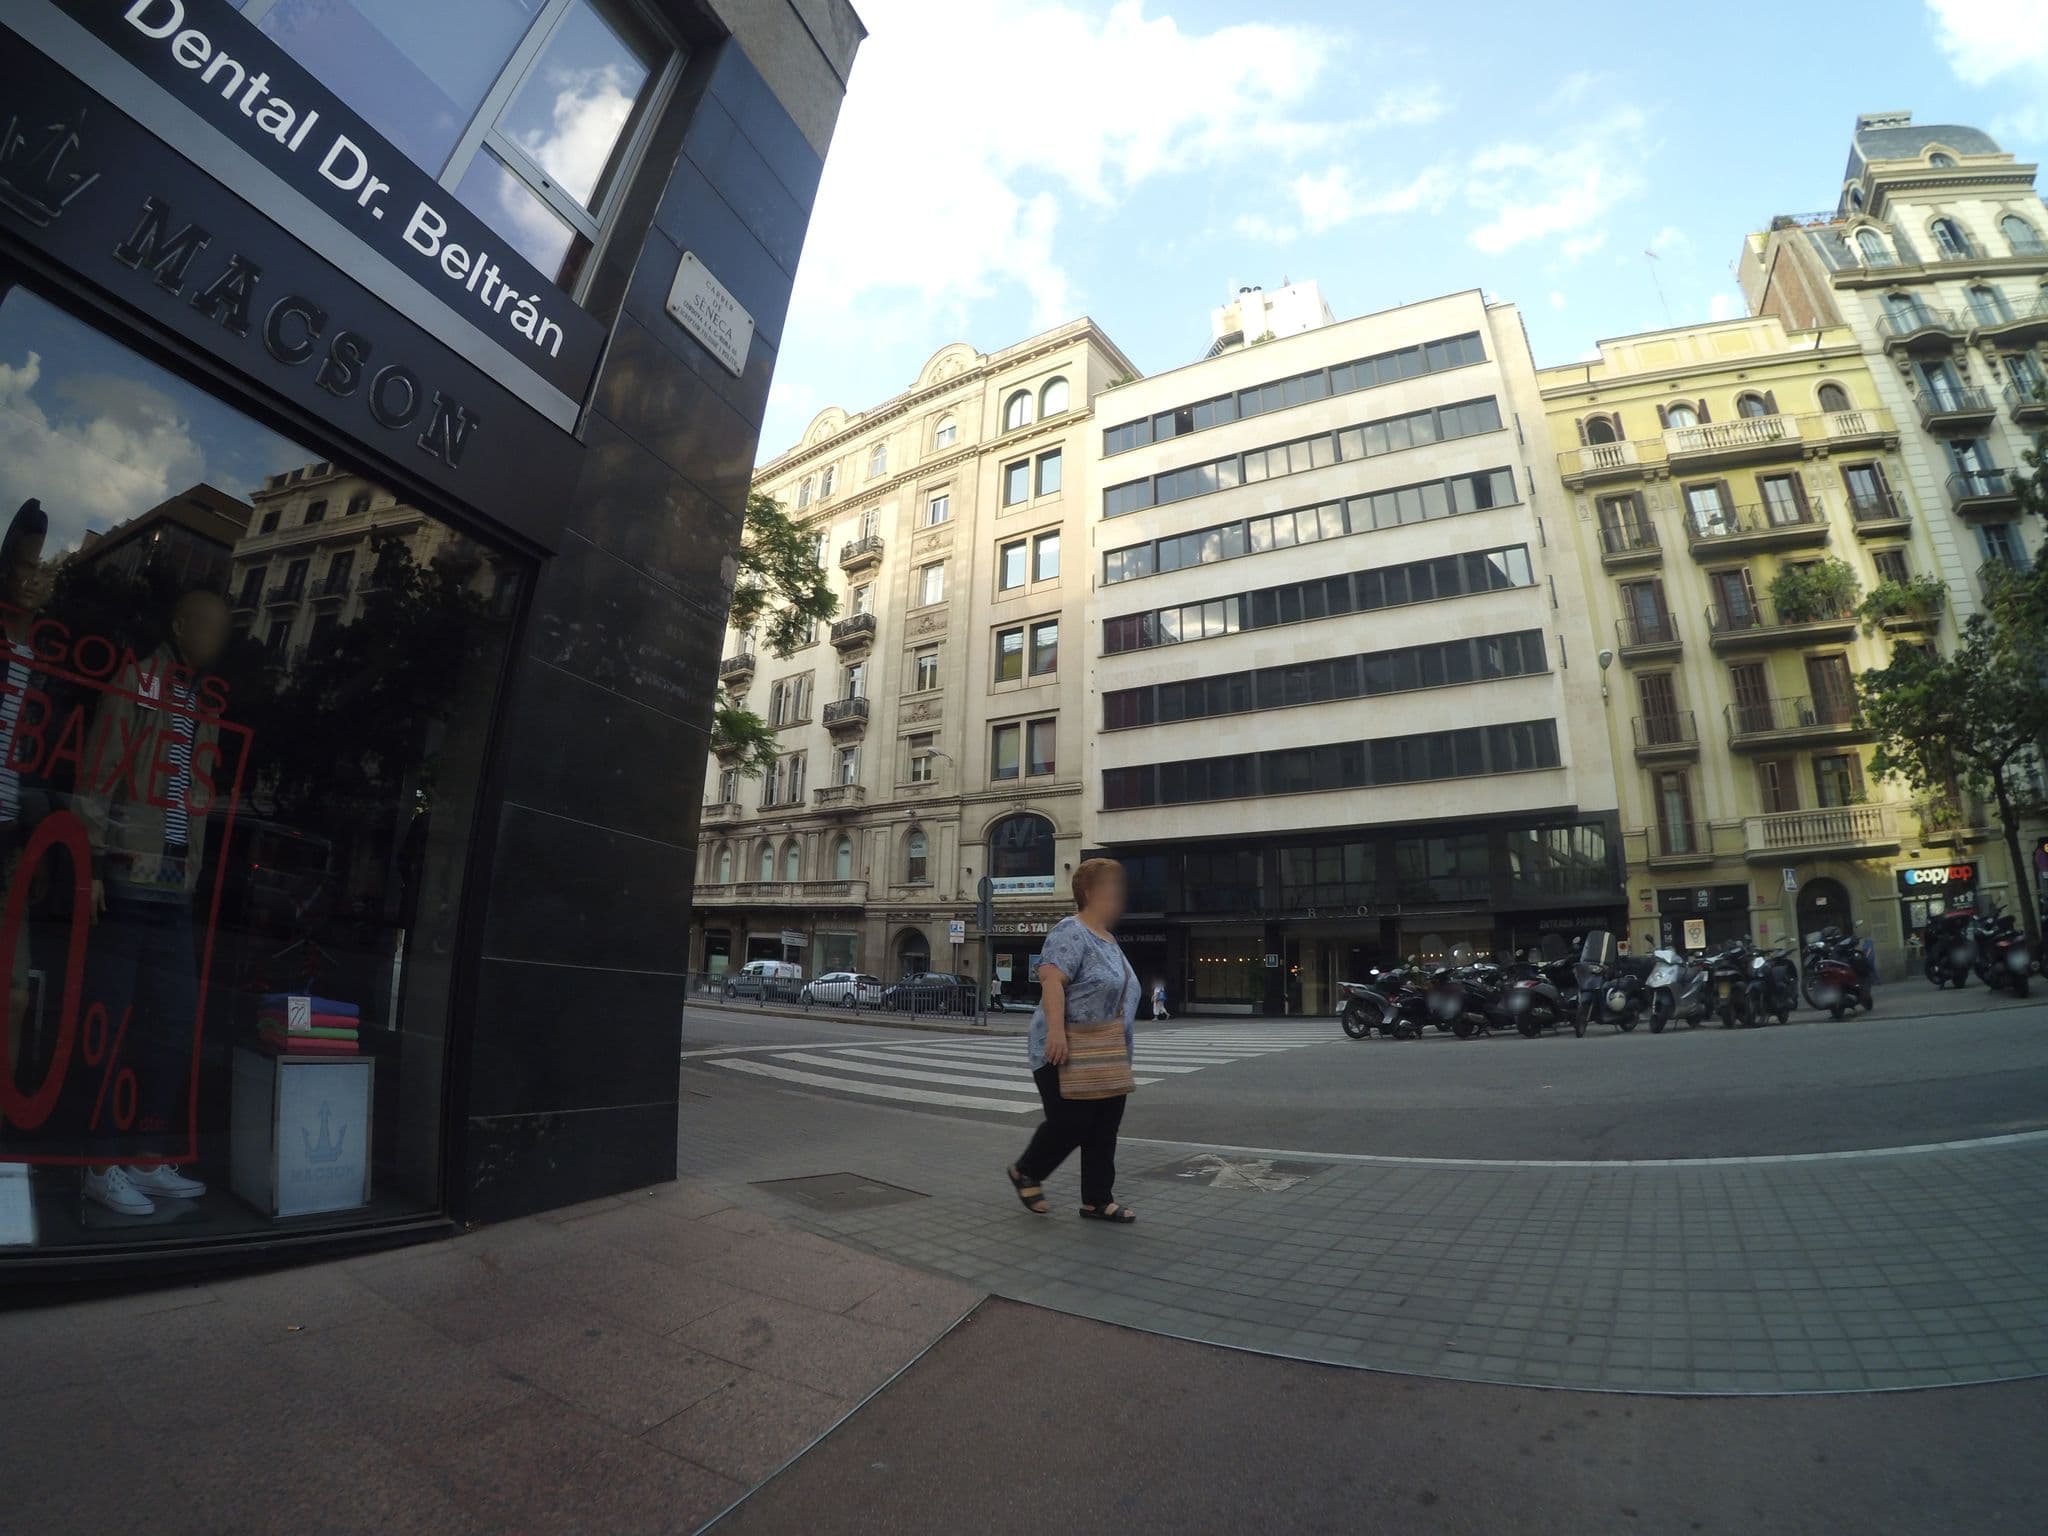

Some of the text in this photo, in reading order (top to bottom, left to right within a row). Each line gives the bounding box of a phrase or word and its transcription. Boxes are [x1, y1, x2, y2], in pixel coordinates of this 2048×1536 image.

[112, 196, 480, 470] MACSON
[124, 0, 564, 358] Dental Dr. Beltrán
